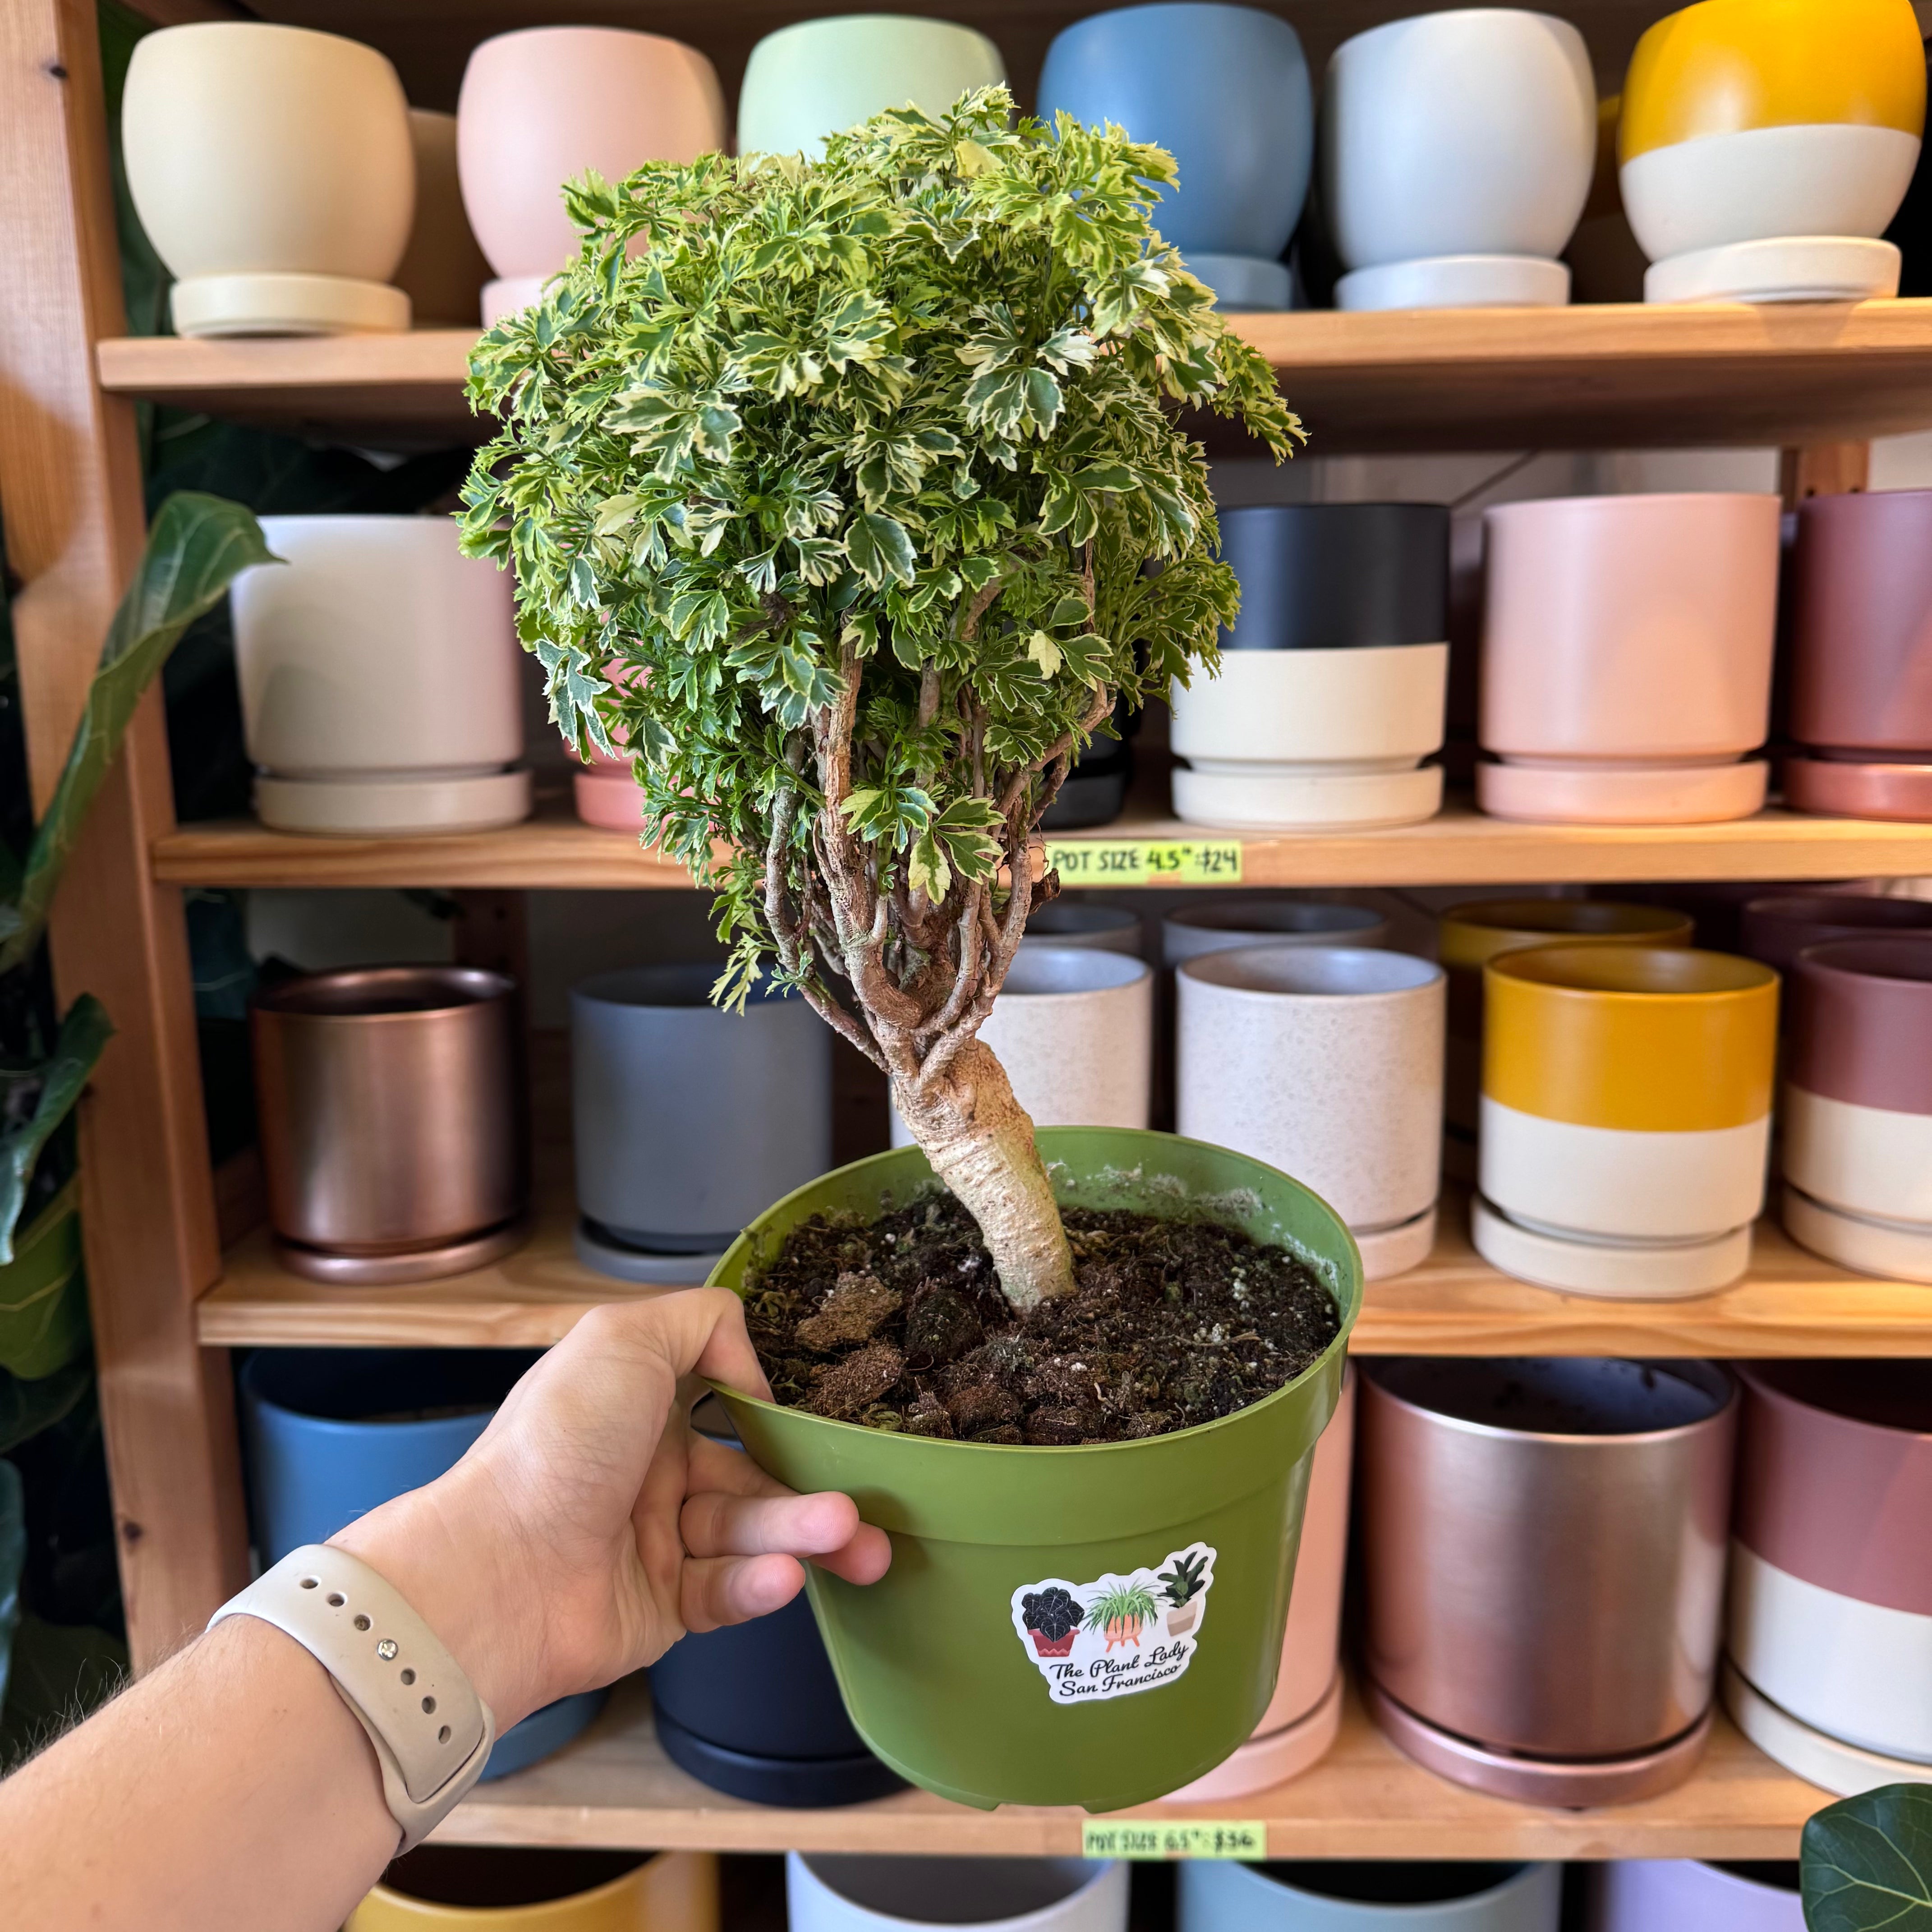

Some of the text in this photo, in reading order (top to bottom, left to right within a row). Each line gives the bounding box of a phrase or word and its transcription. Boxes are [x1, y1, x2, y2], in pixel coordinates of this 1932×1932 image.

[1053, 849, 1090, 871] POT
[1098, 848, 1139, 871] SIZE
[1049, 1641, 1189, 1680] The Plant Lady
[1059, 1664, 1182, 1697] San Francisco
